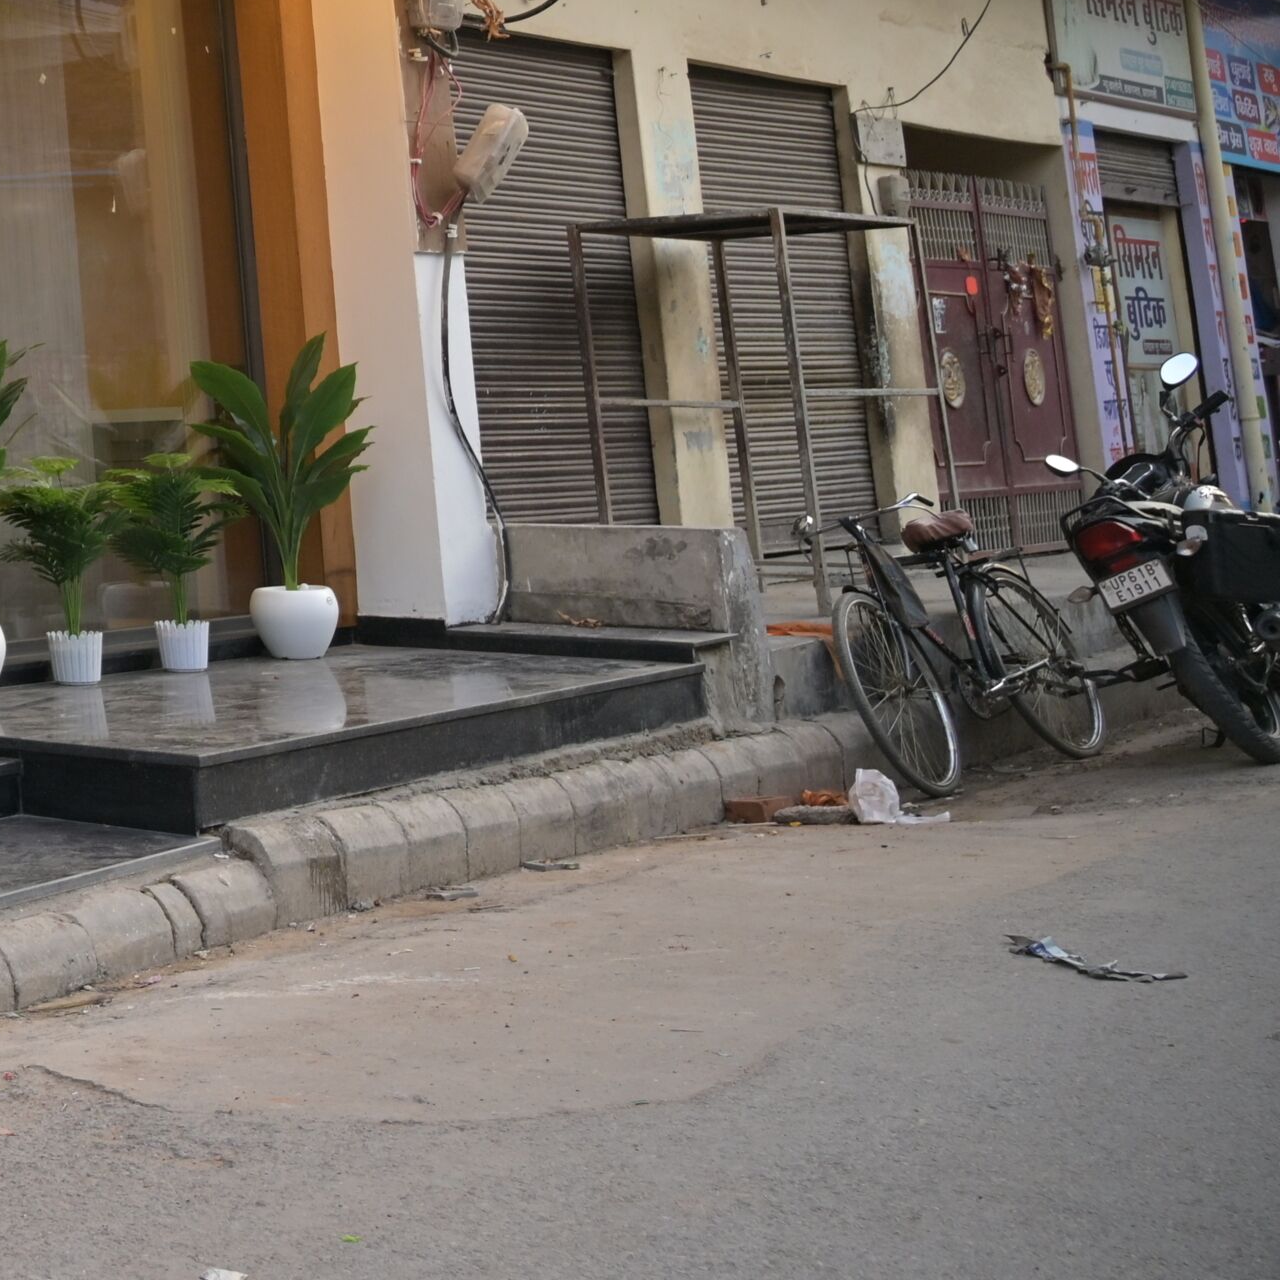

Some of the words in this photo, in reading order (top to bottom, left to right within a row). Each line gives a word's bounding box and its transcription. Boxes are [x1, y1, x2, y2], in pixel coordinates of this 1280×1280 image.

[1112, 223, 1164, 281] सिमरन
[1109, 563, 1156, 591] UP61B
[1115, 576, 1162, 603] E1911
